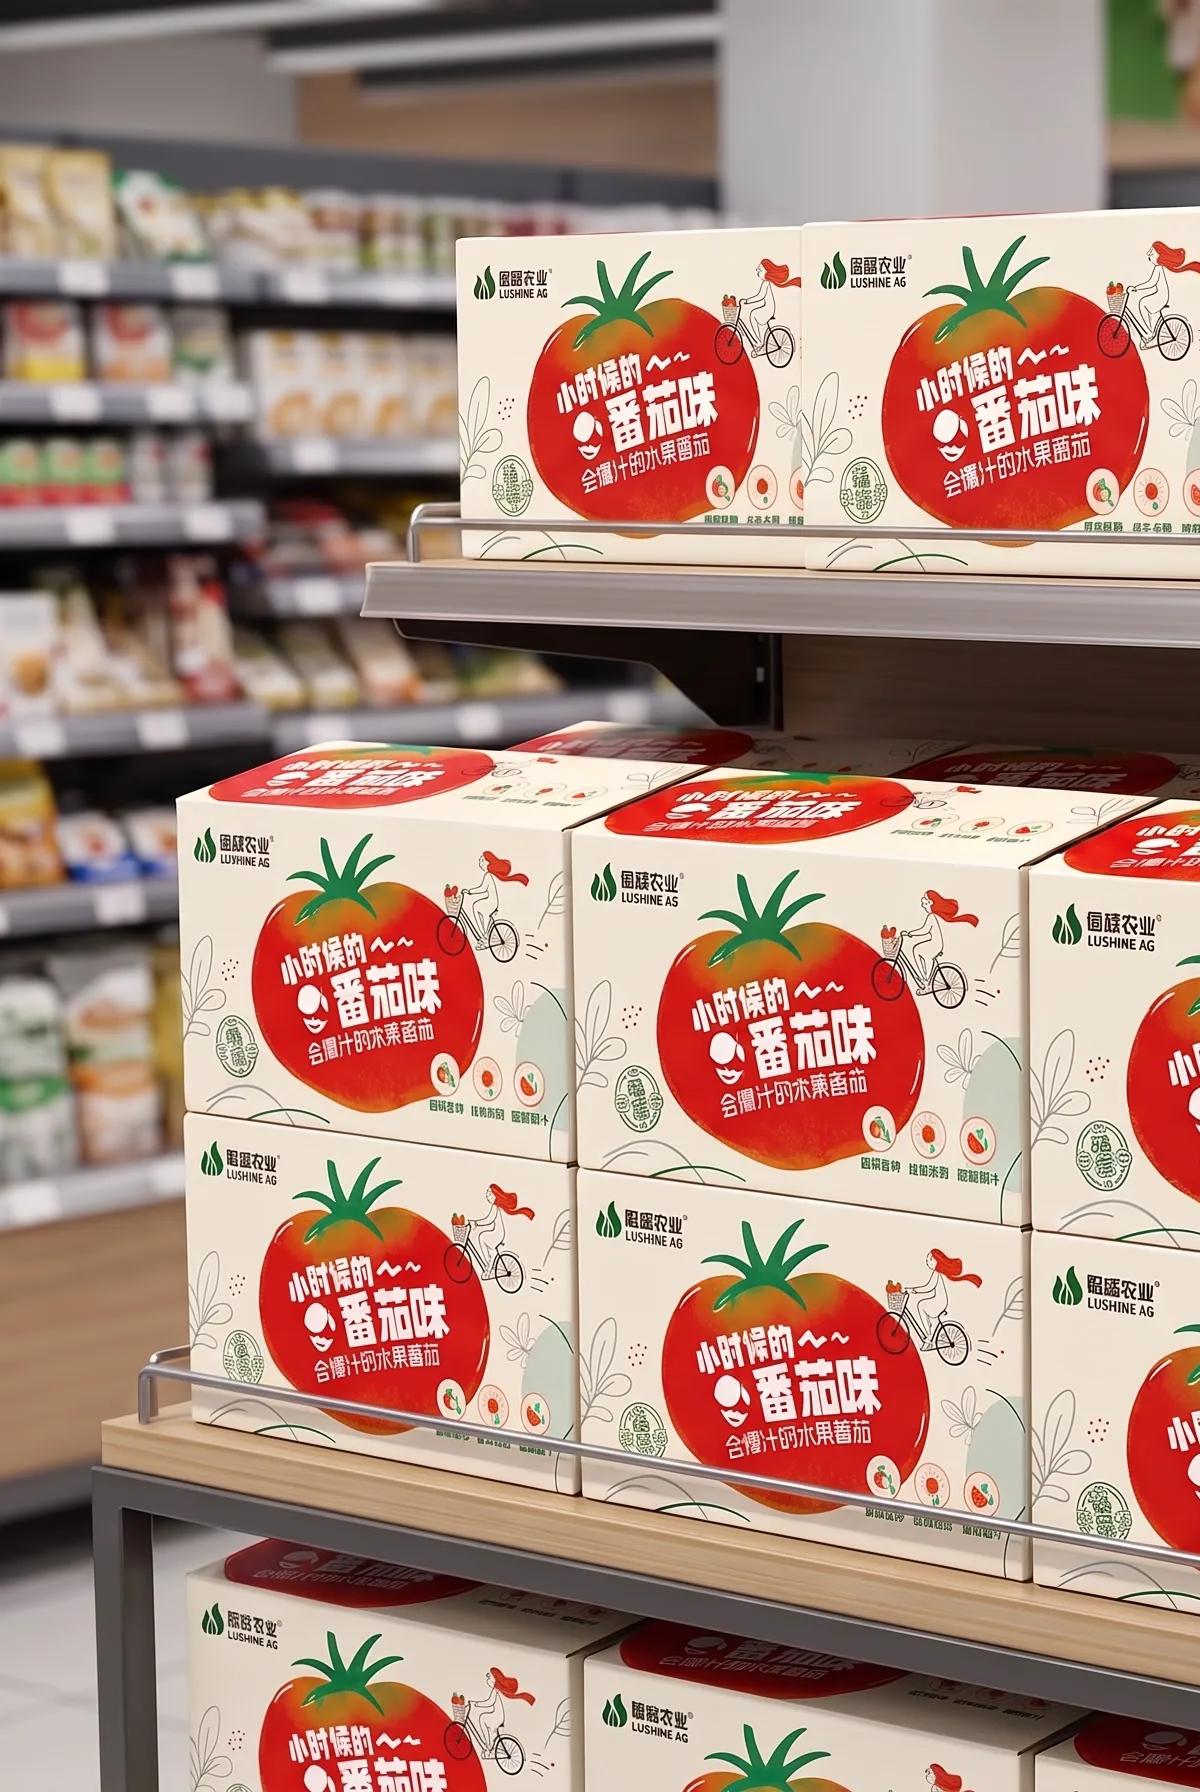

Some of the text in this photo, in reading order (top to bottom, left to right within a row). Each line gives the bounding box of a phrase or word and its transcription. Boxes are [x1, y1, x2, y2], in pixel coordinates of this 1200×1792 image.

[499, 288, 534, 299] LUSHINE
[850, 277, 891, 289] LUSHINE
[556, 353, 642, 414] 小时候的
[915, 345, 1014, 412] 小时候的
[605, 372, 718, 452] 番茄味
[971, 364, 1102, 453] 番茄味
[621, 891, 663, 906] LUSHINE
[280, 932, 367, 987] 小时候的
[1087, 936, 1137, 951] LUSHINE
[330, 958, 443, 1029] 番茄味
[691, 976, 791, 1034] 小时候的
[748, 1004, 878, 1080] 番茄味
[226, 1168, 264, 1185] LUSHINE
[625, 1229, 667, 1248] LUSHINE
[288, 1255, 375, 1304] 小时候的
[340, 1283, 451, 1348] 番茄味
[1087, 1297, 1135, 1317] LUSHINE
[695, 1324, 796, 1377] 小时候的
[755, 1358, 883, 1424] 番茄味
[227, 1630, 265, 1647] LUSHINE
[288, 1724, 375, 1764] 小时候的
[631, 1721, 674, 1740] LUSHINE
